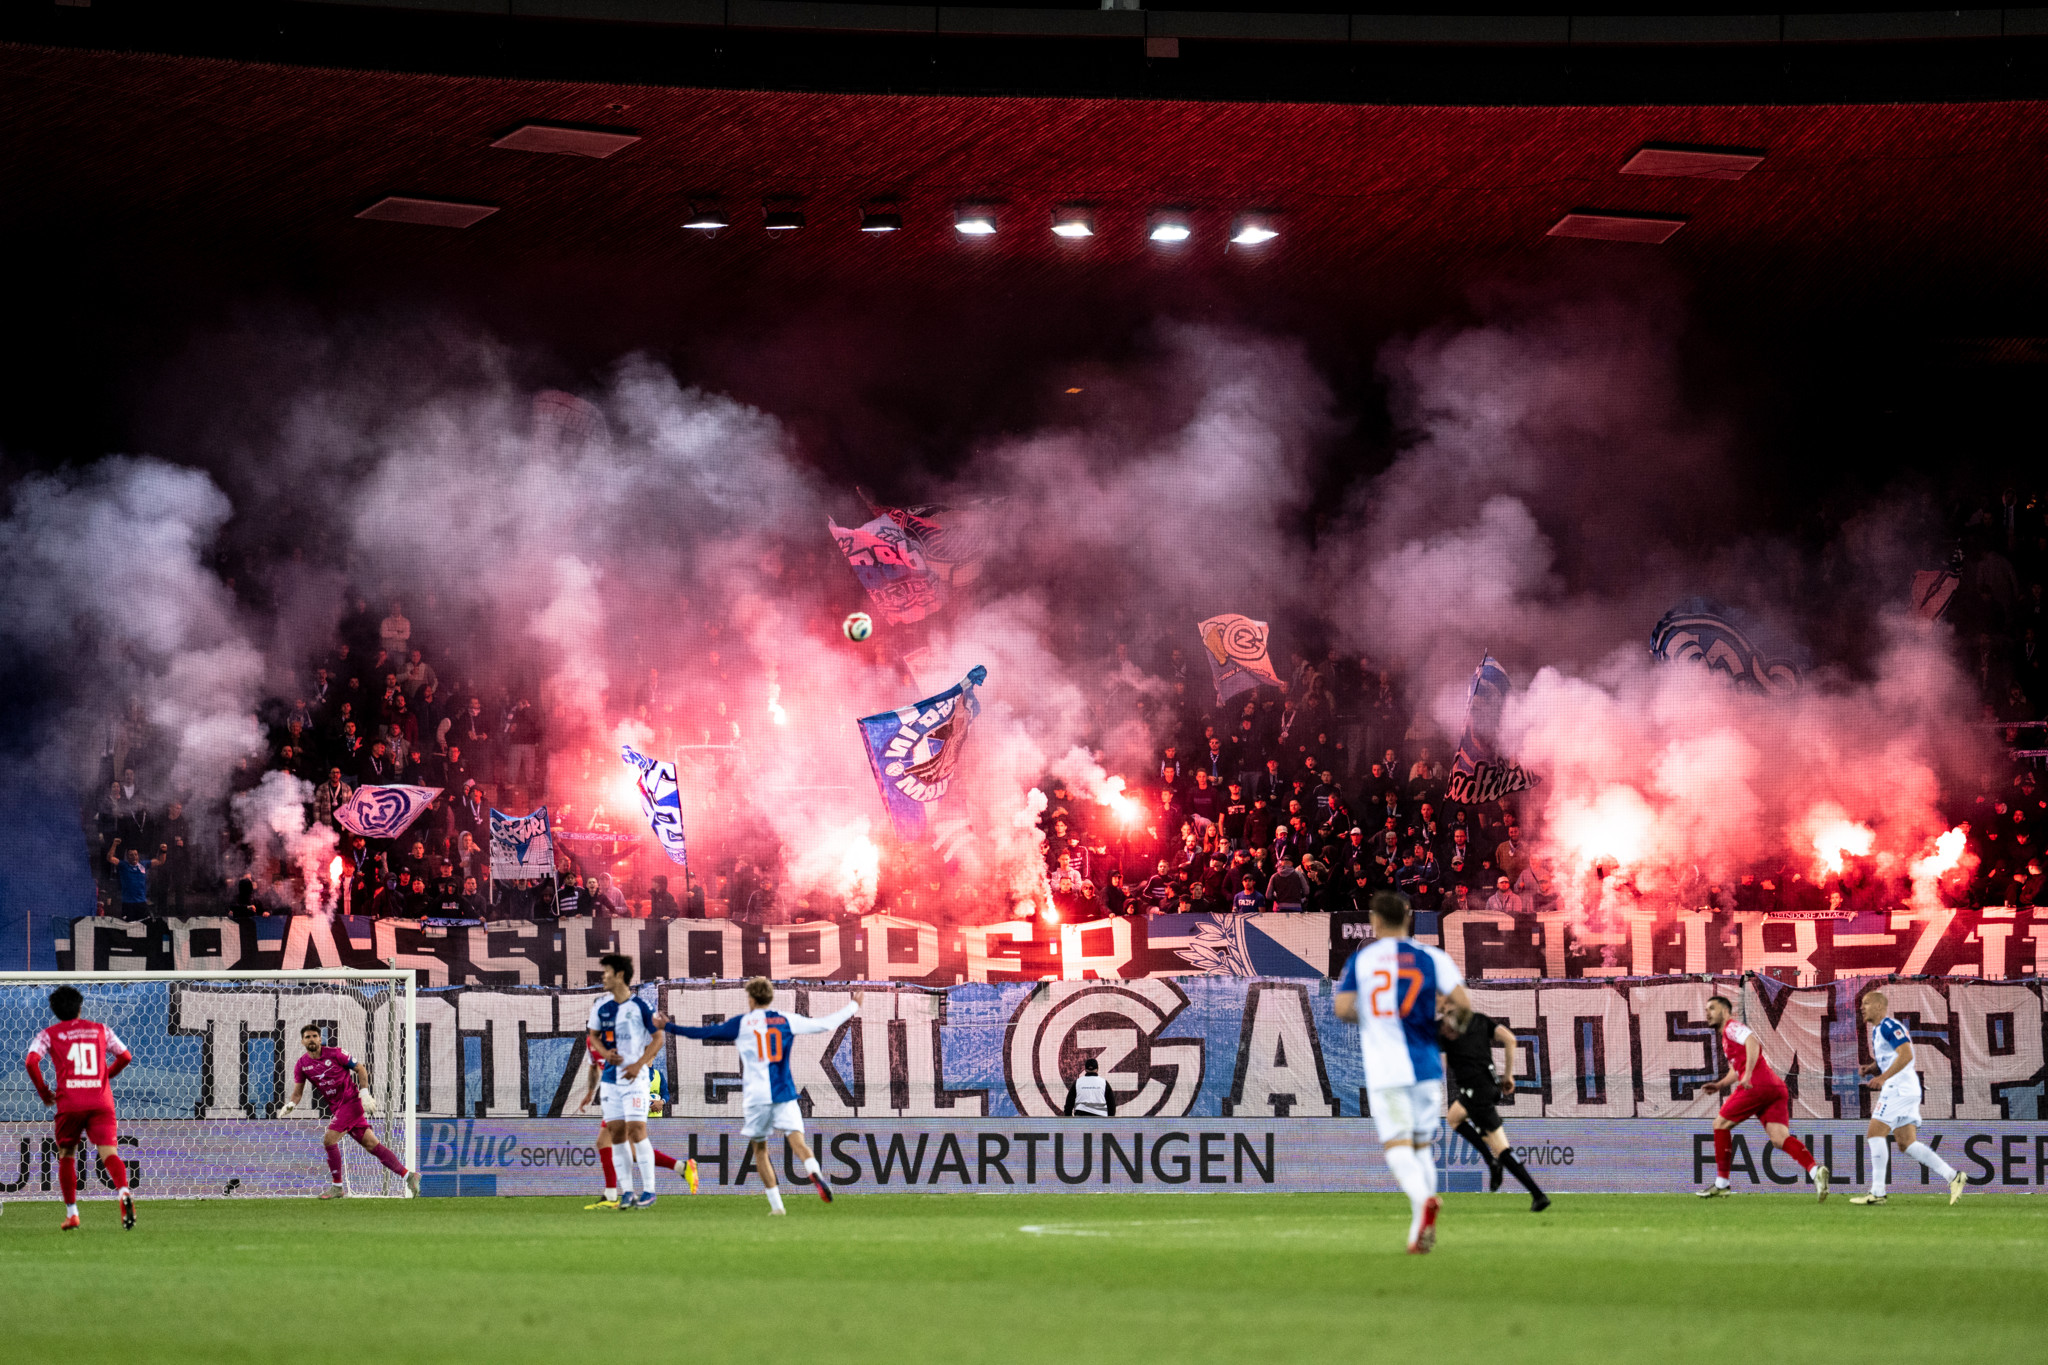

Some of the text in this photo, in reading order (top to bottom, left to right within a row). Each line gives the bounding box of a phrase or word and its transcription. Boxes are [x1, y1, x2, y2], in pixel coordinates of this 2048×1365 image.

[1371, 968, 1424, 1017] 27
[67, 1043, 98, 1076] 10
[753, 1027, 783, 1062] 10
[1222, 982, 1340, 1117] A
[423, 1119, 596, 1167] Blue service
[688, 1131, 1275, 1187] HAUSWARTUNGEN
[1508, 1140, 1575, 1165] ervice
